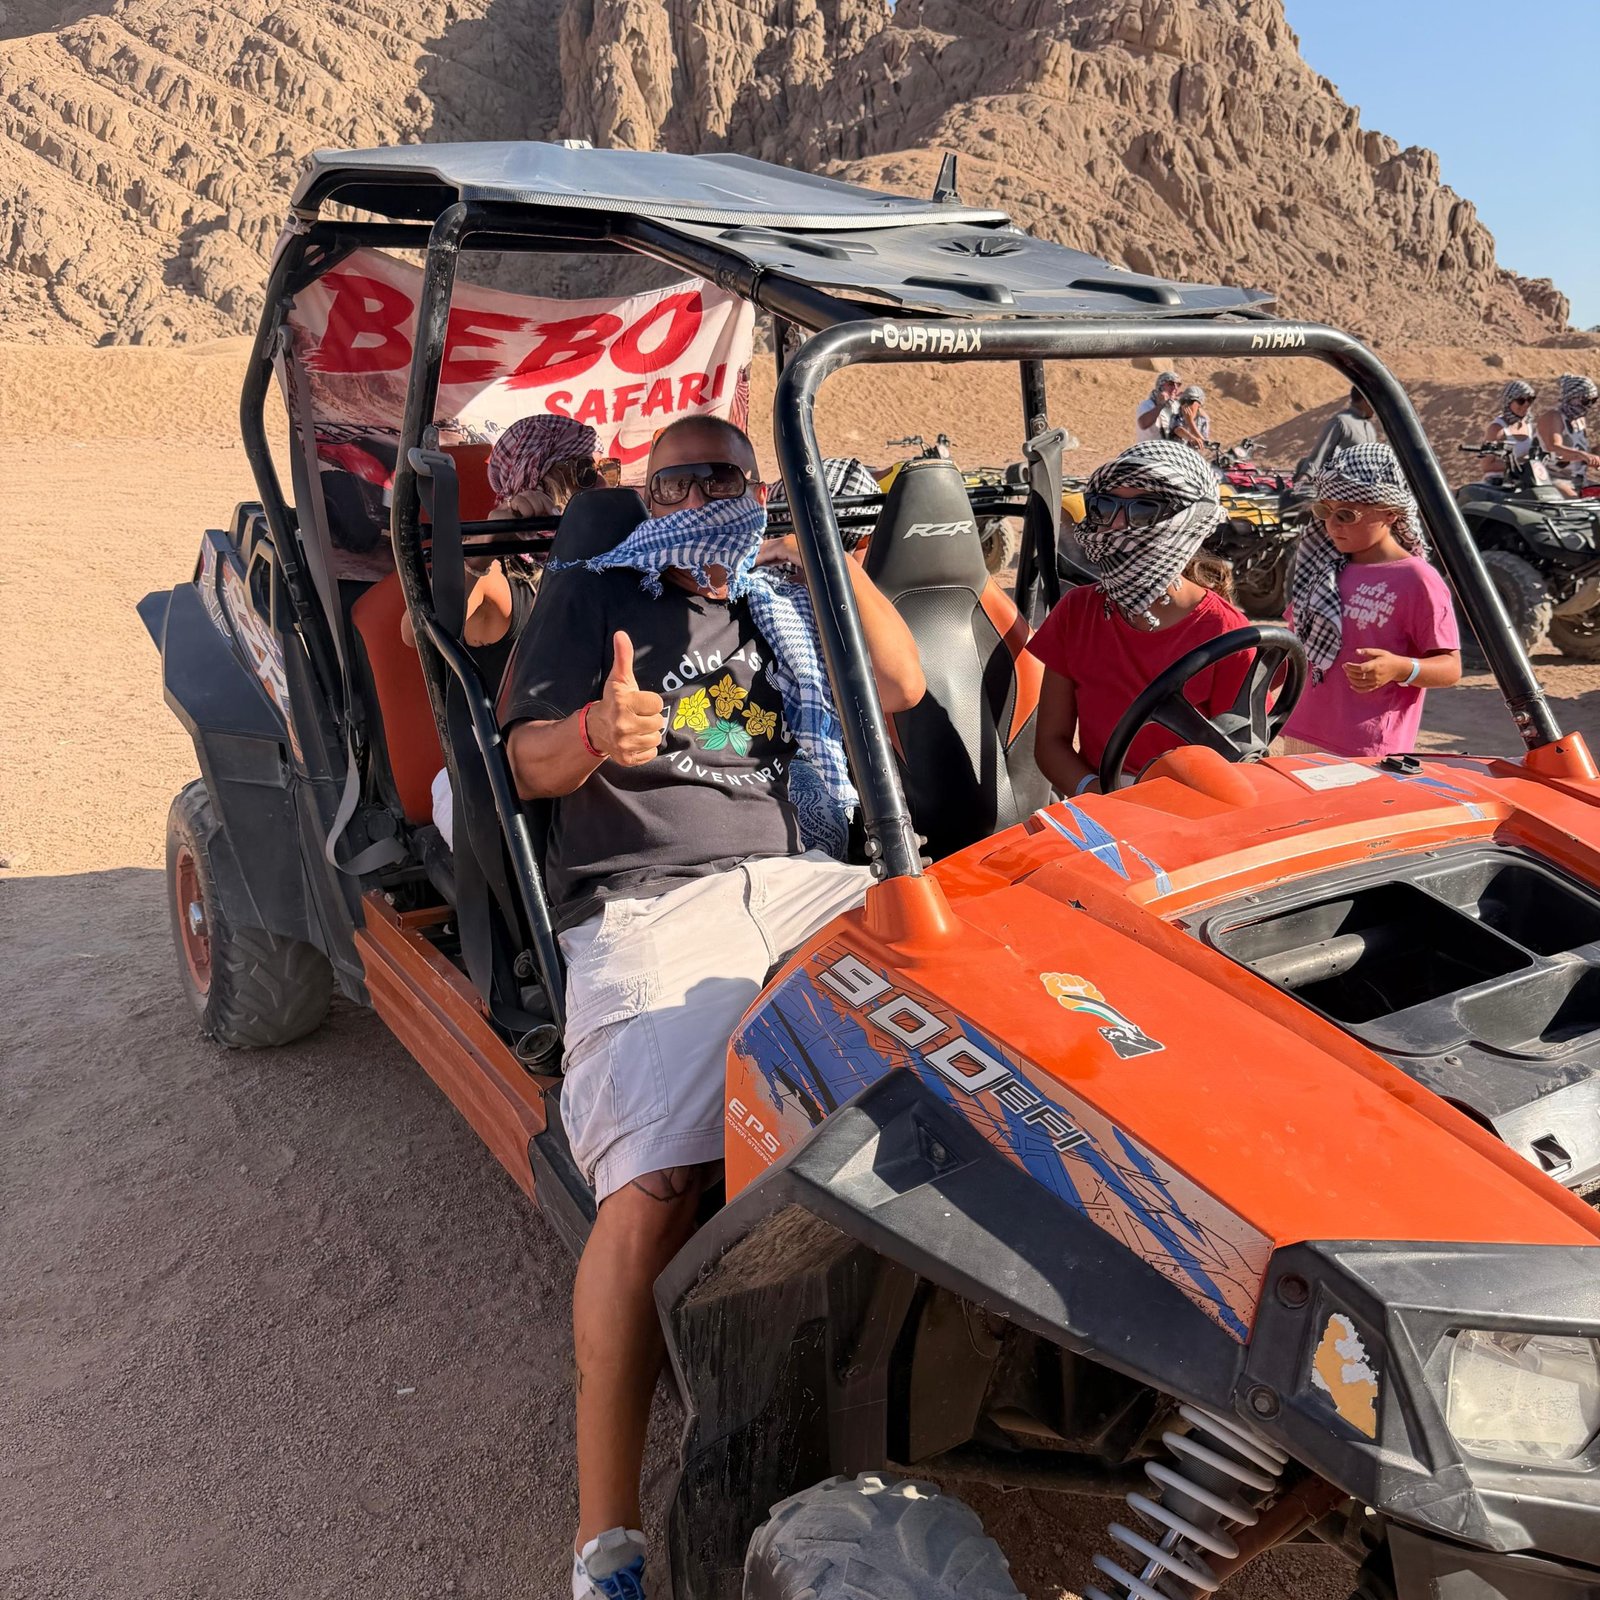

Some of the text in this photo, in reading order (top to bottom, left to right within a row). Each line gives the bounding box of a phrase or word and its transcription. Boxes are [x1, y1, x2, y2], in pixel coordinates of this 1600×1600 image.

[301, 272, 703, 390] BEBO
[544, 362, 728, 425] SAFARI
[903, 519, 974, 540] RZR
[817, 953, 1091, 1153] 900 EFI
[728, 1097, 781, 1154] EPS
